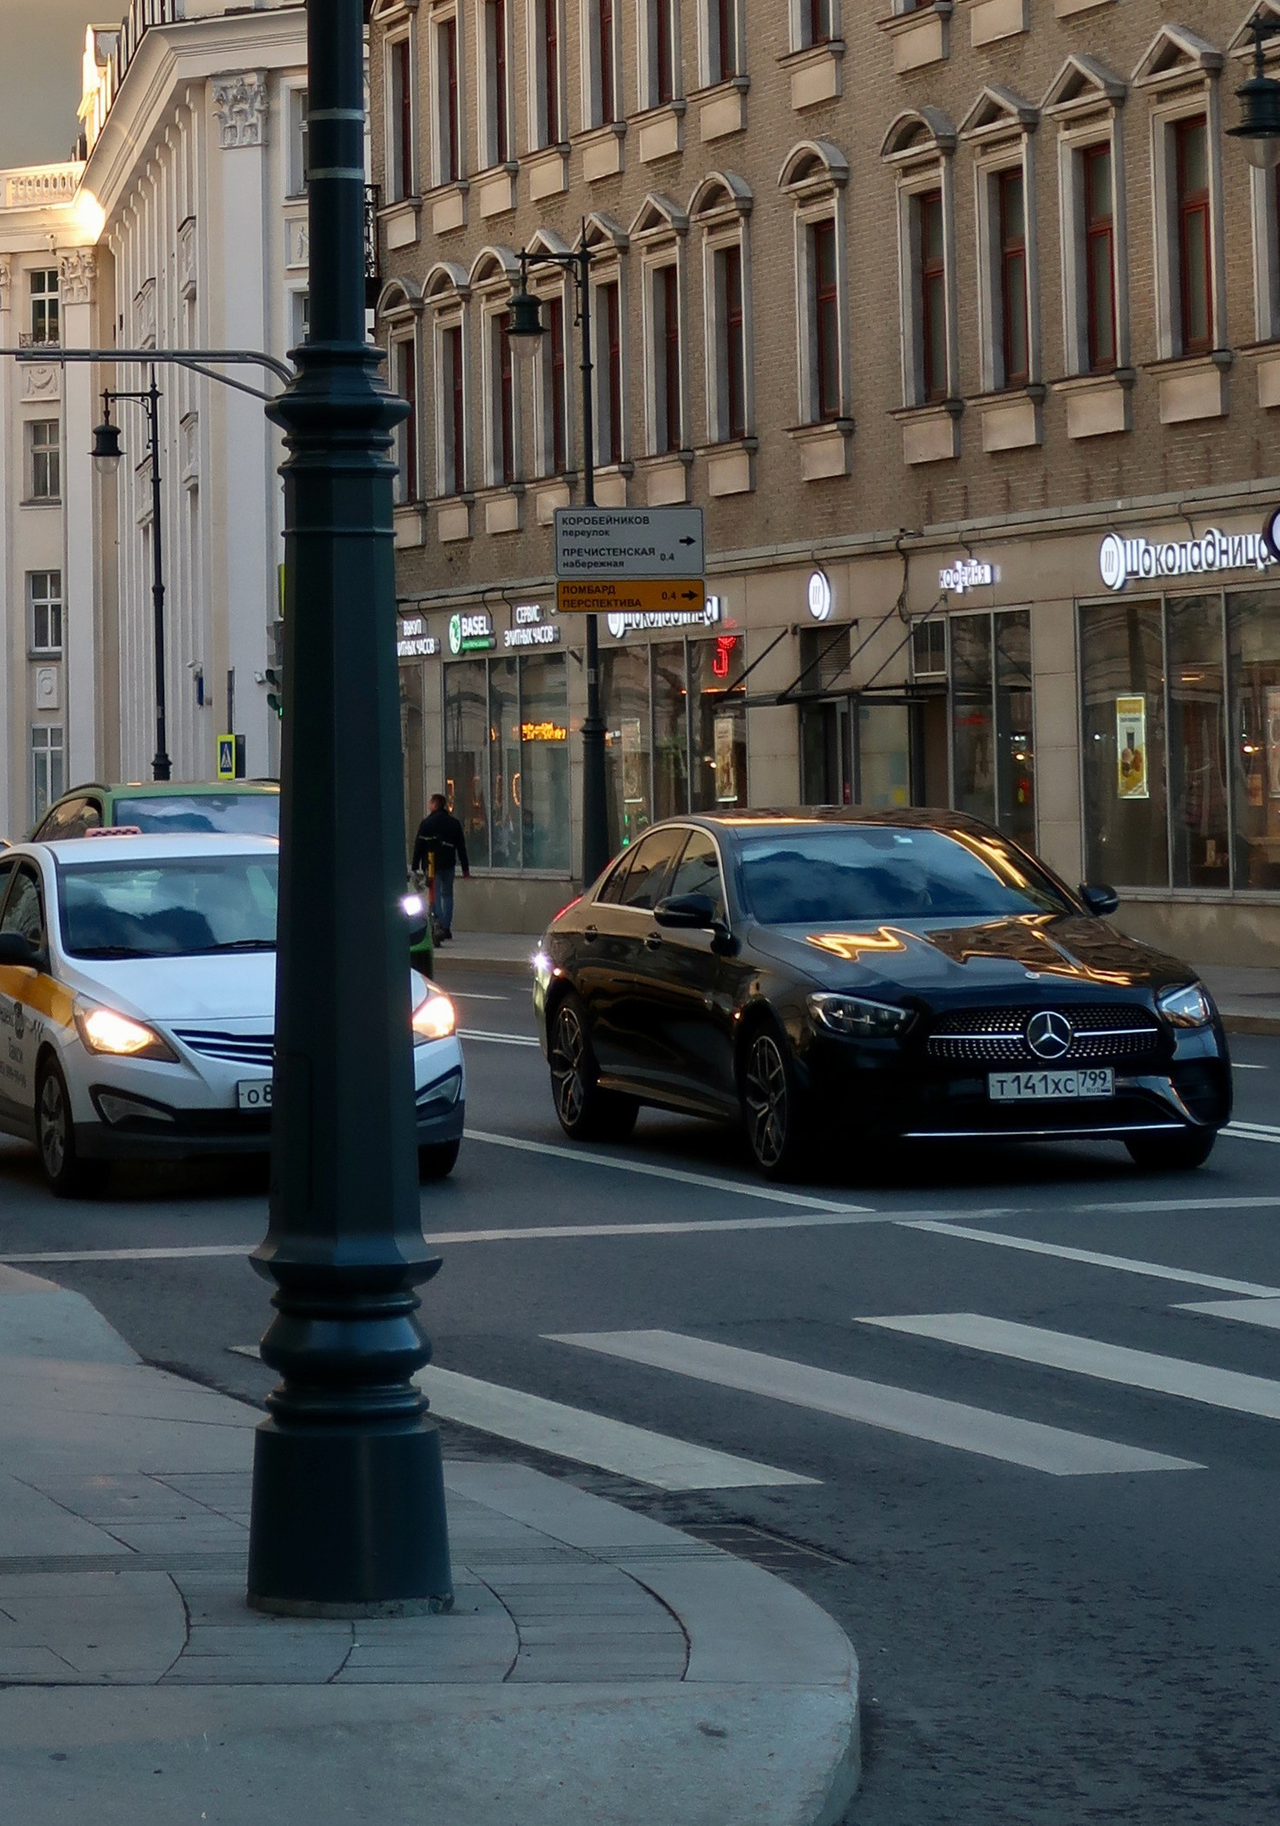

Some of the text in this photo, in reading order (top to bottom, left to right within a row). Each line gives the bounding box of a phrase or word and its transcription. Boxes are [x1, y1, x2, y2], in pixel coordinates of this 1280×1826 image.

[562, 515, 650, 526] КОРОБЕЙНИКОВ
[562, 529, 610, 539] переулок
[562, 547, 655, 557] ПРЕЧИСТЕНСКАЯ
[660, 553, 675, 562] 0.4
[1123, 528, 1271, 579] Шоколадница
[562, 560, 625, 569] набережная
[939, 558, 992, 594] кофейня
[562, 585, 616, 595] ЛОМБАРД
[661, 591, 677, 601] 0.4
[562, 598, 642, 608] ПЕРСПЕКТИВА
[516, 604, 540, 624] СЕРВИС
[461, 615, 490, 637] BASEL
[533, 626, 554, 643] ЧАСОВ
[417, 638, 435, 654] ЧАСОВ
[1079, 1070, 1107, 1088] 799
